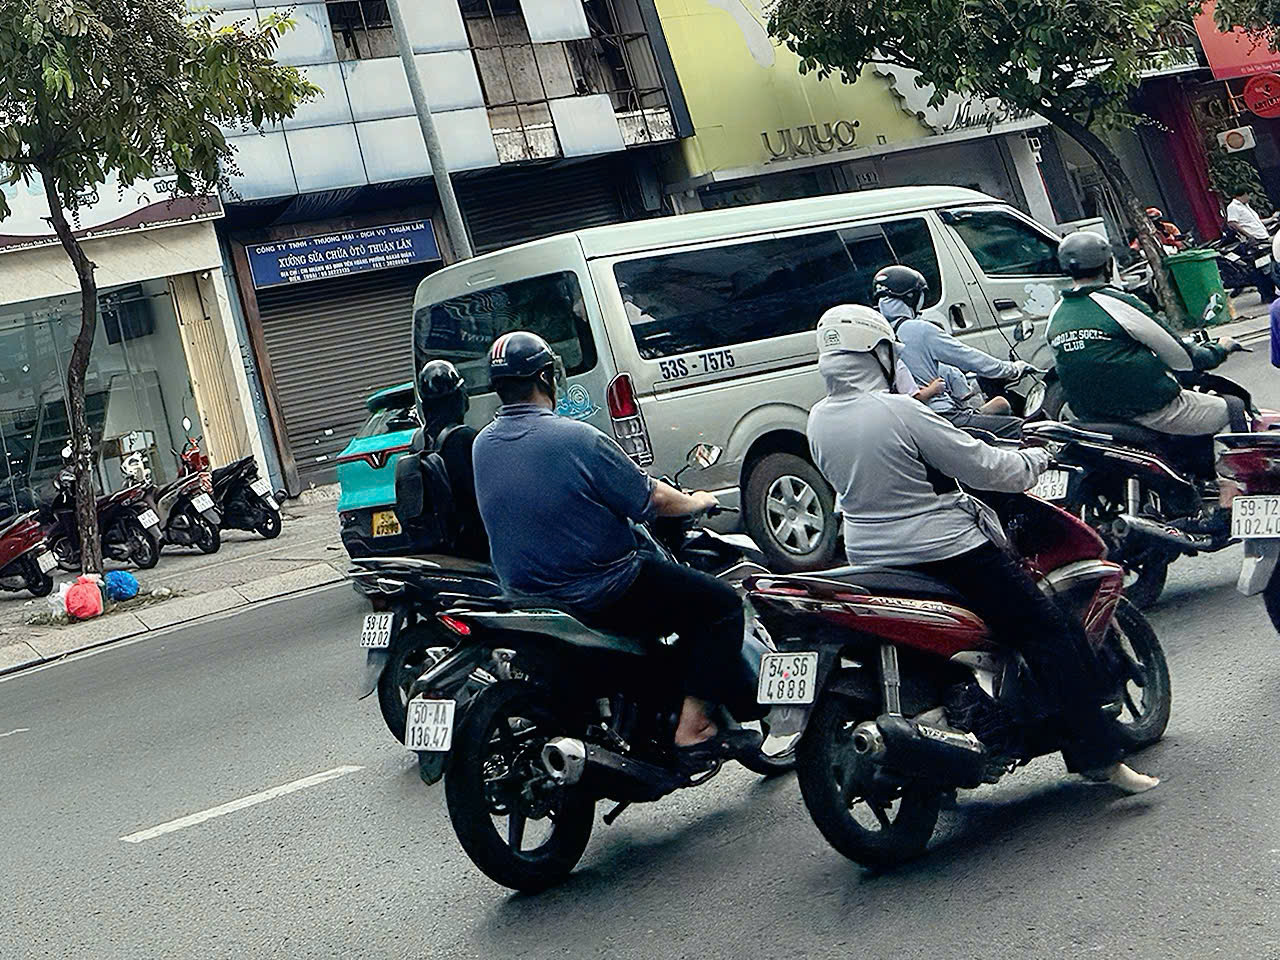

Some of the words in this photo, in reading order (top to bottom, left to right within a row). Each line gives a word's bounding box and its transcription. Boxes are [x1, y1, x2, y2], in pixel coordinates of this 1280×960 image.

[1063, 340, 1086, 352] CLUB
[658, 359, 690, 381] 53S
[698, 349, 736, 373] 7575
[766, 679, 807, 700] 4888
[409, 726, 450, 748] 136.47
